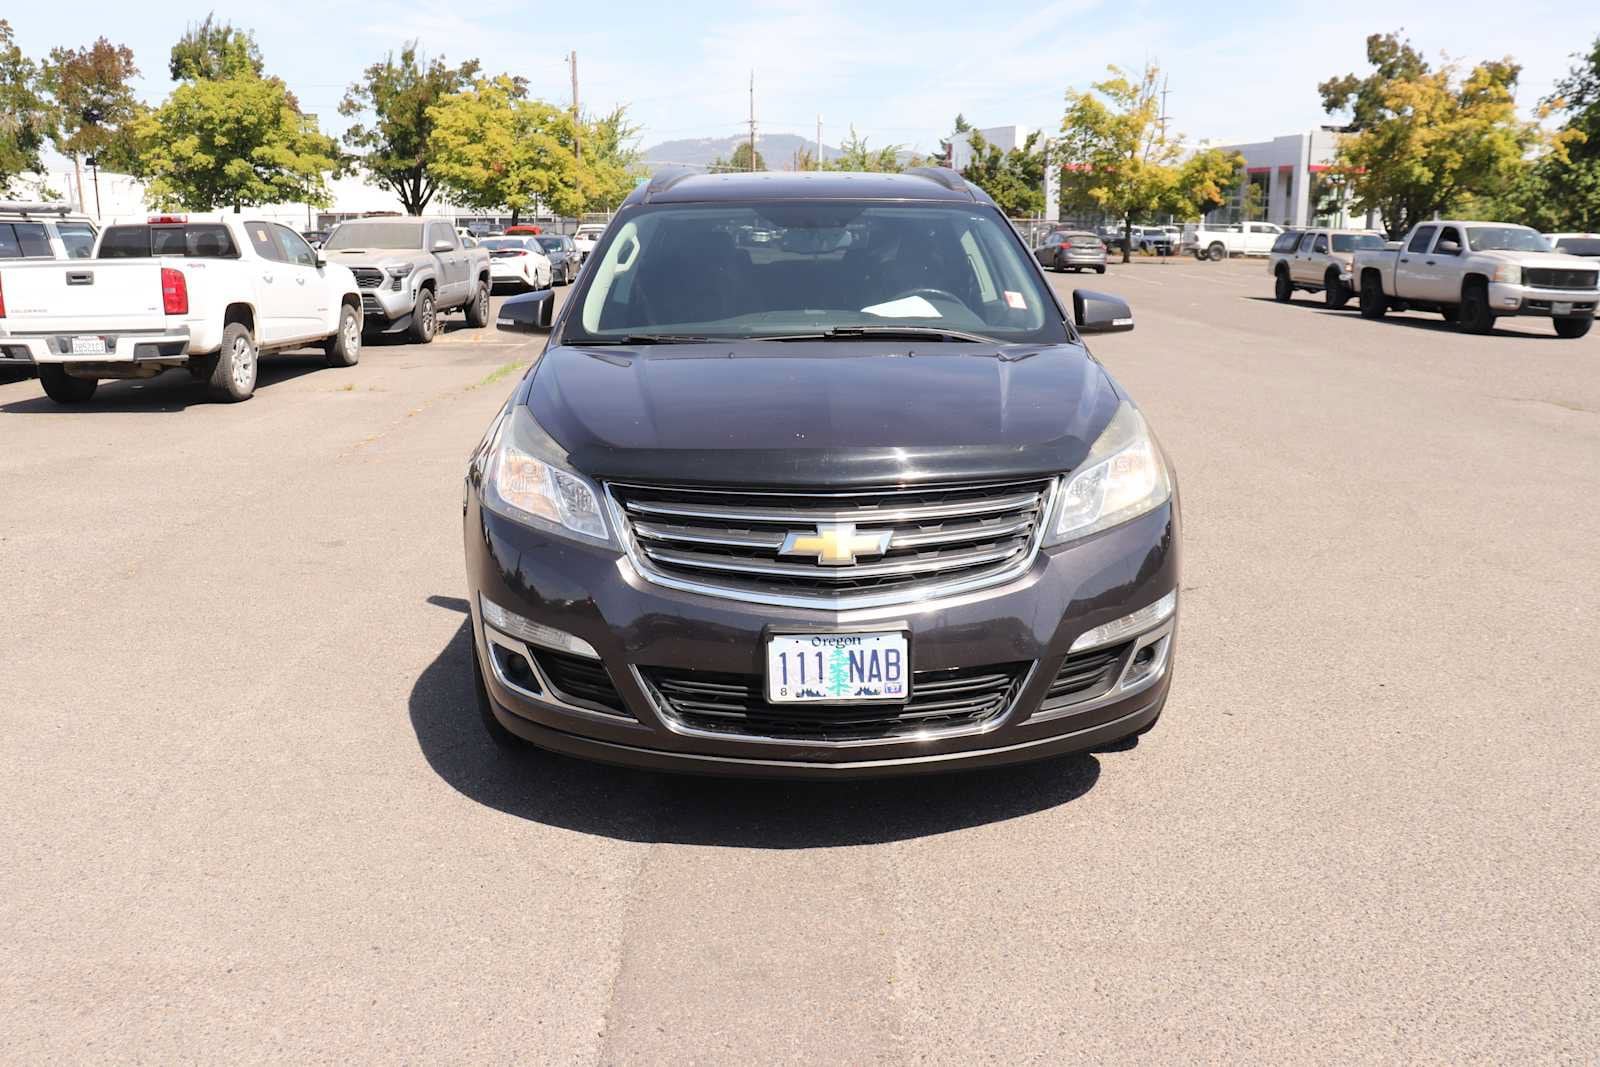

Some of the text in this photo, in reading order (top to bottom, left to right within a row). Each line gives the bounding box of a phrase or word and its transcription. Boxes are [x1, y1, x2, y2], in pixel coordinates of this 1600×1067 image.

[811, 636, 861, 649] Oregon
[778, 649, 901, 685] 111 NAB
